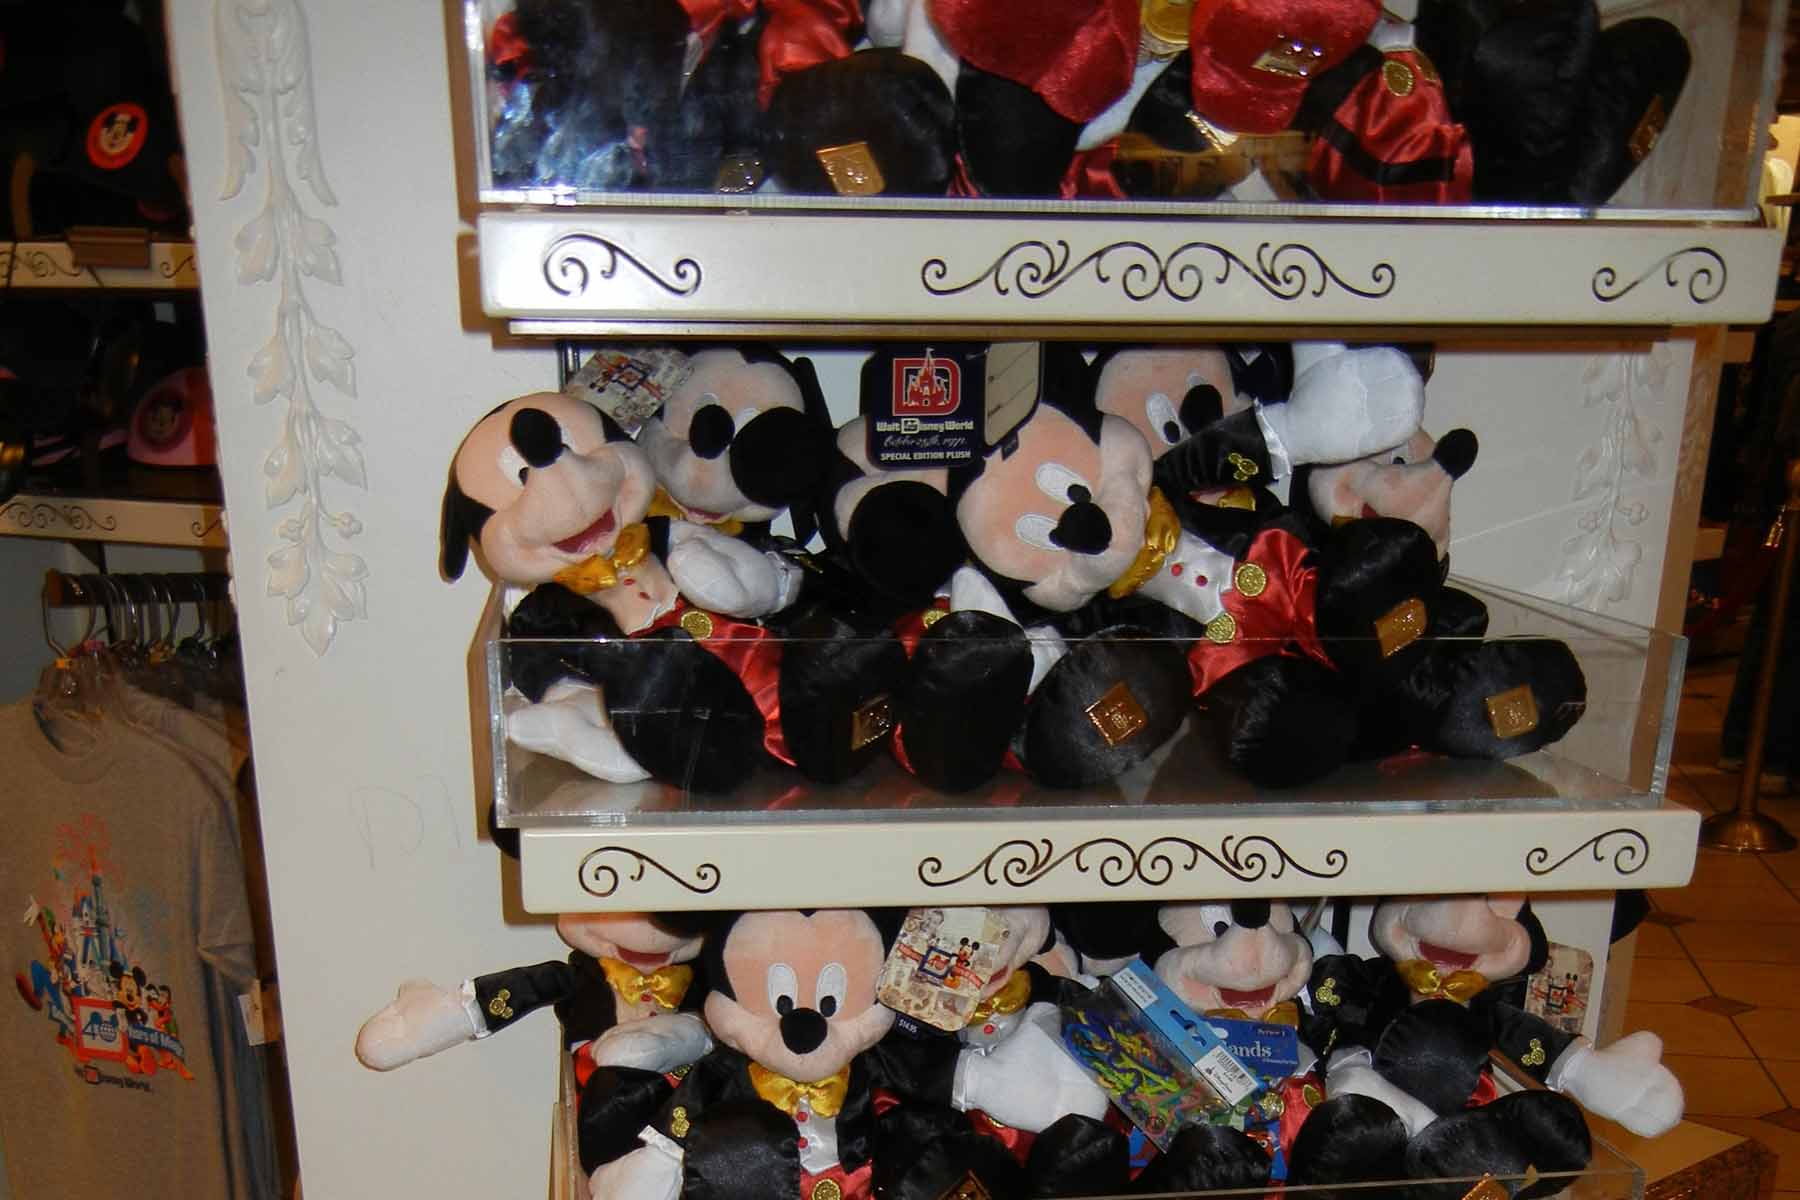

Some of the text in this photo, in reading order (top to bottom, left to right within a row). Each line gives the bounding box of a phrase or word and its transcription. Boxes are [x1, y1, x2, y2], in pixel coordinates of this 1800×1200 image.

[876, 417, 974, 434] Walt Disney World
[880, 450, 971, 461] SPECIAL EDITION PLUSH
[1231, 1040, 1272, 1057] ands
